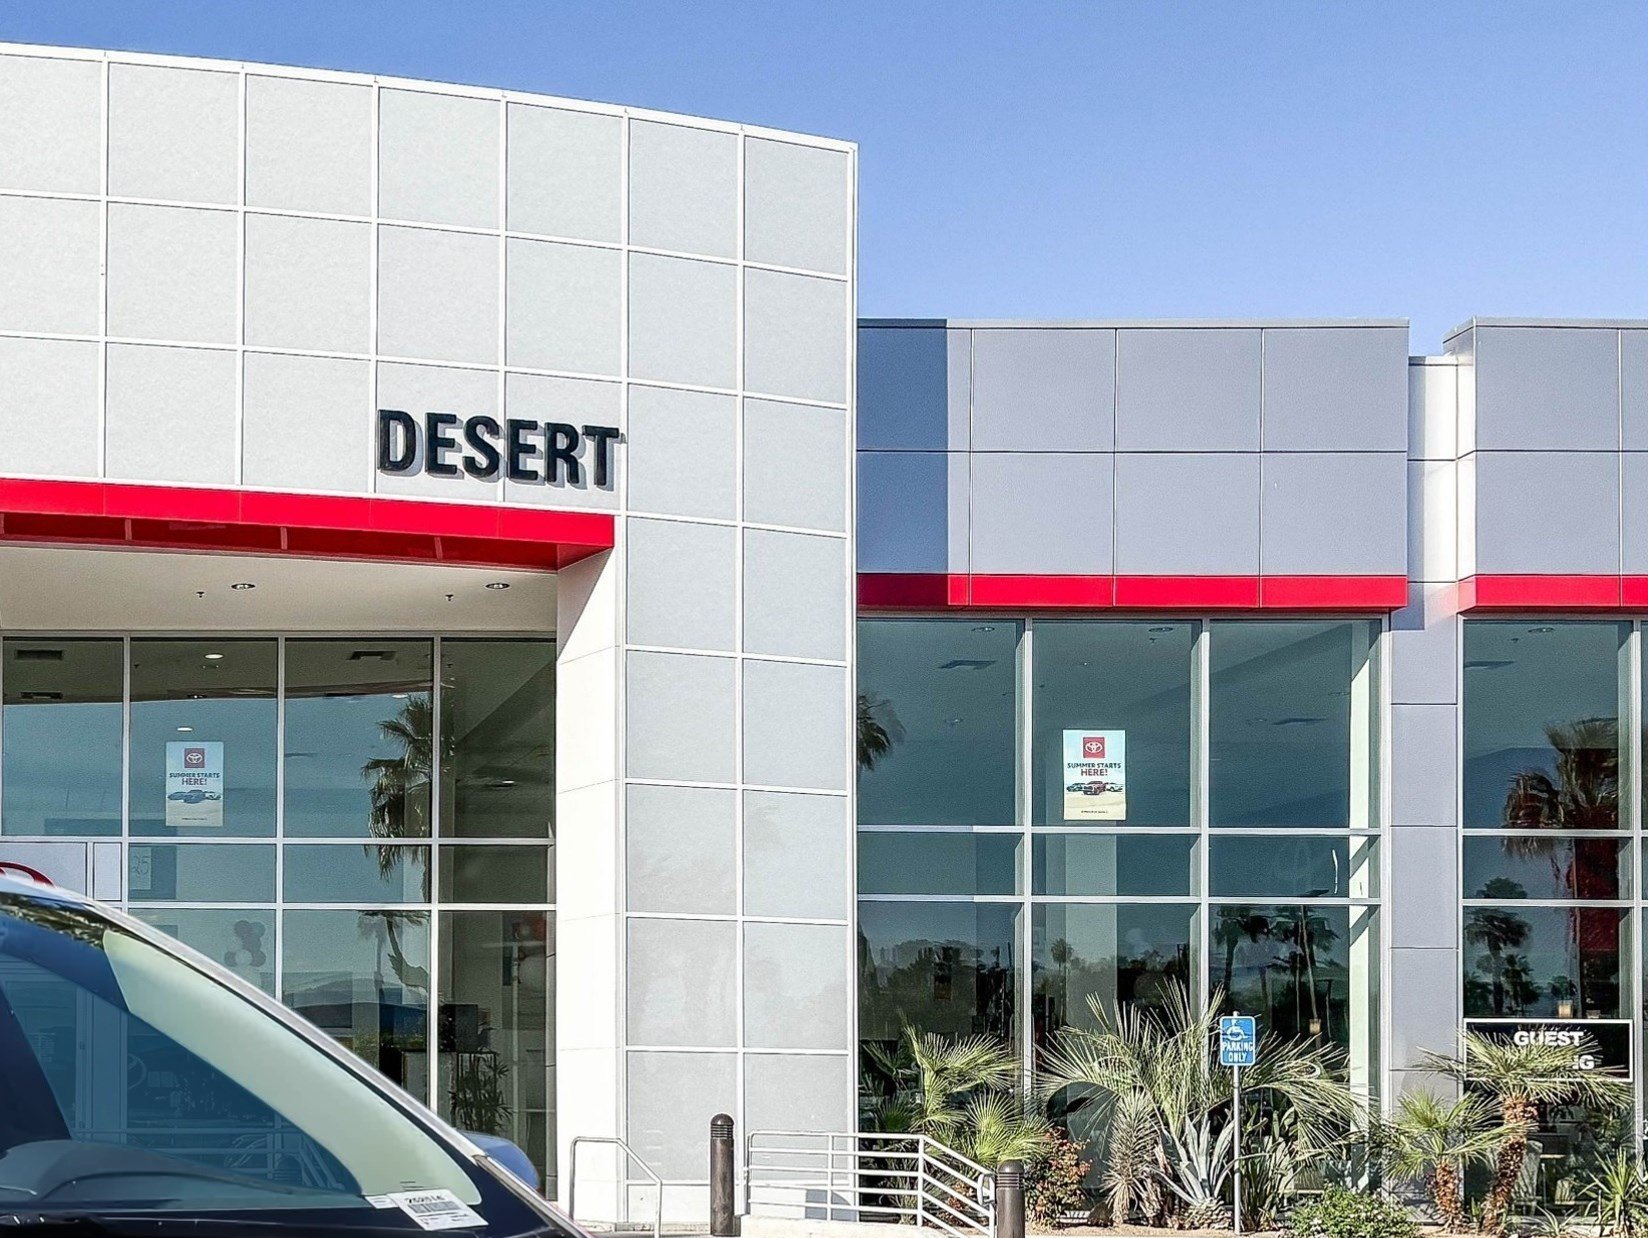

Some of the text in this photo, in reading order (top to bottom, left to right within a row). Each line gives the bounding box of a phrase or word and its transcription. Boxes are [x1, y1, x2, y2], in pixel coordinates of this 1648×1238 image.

[376, 409, 621, 487] DESERT
[1080, 768, 1108, 776] HERE!
[181, 777, 207, 786] HERE!
[1513, 1030, 1584, 1047] GUEST
[1221, 1041, 1254, 1051] PARKING
[1228, 1052, 1247, 1062] ONLY
